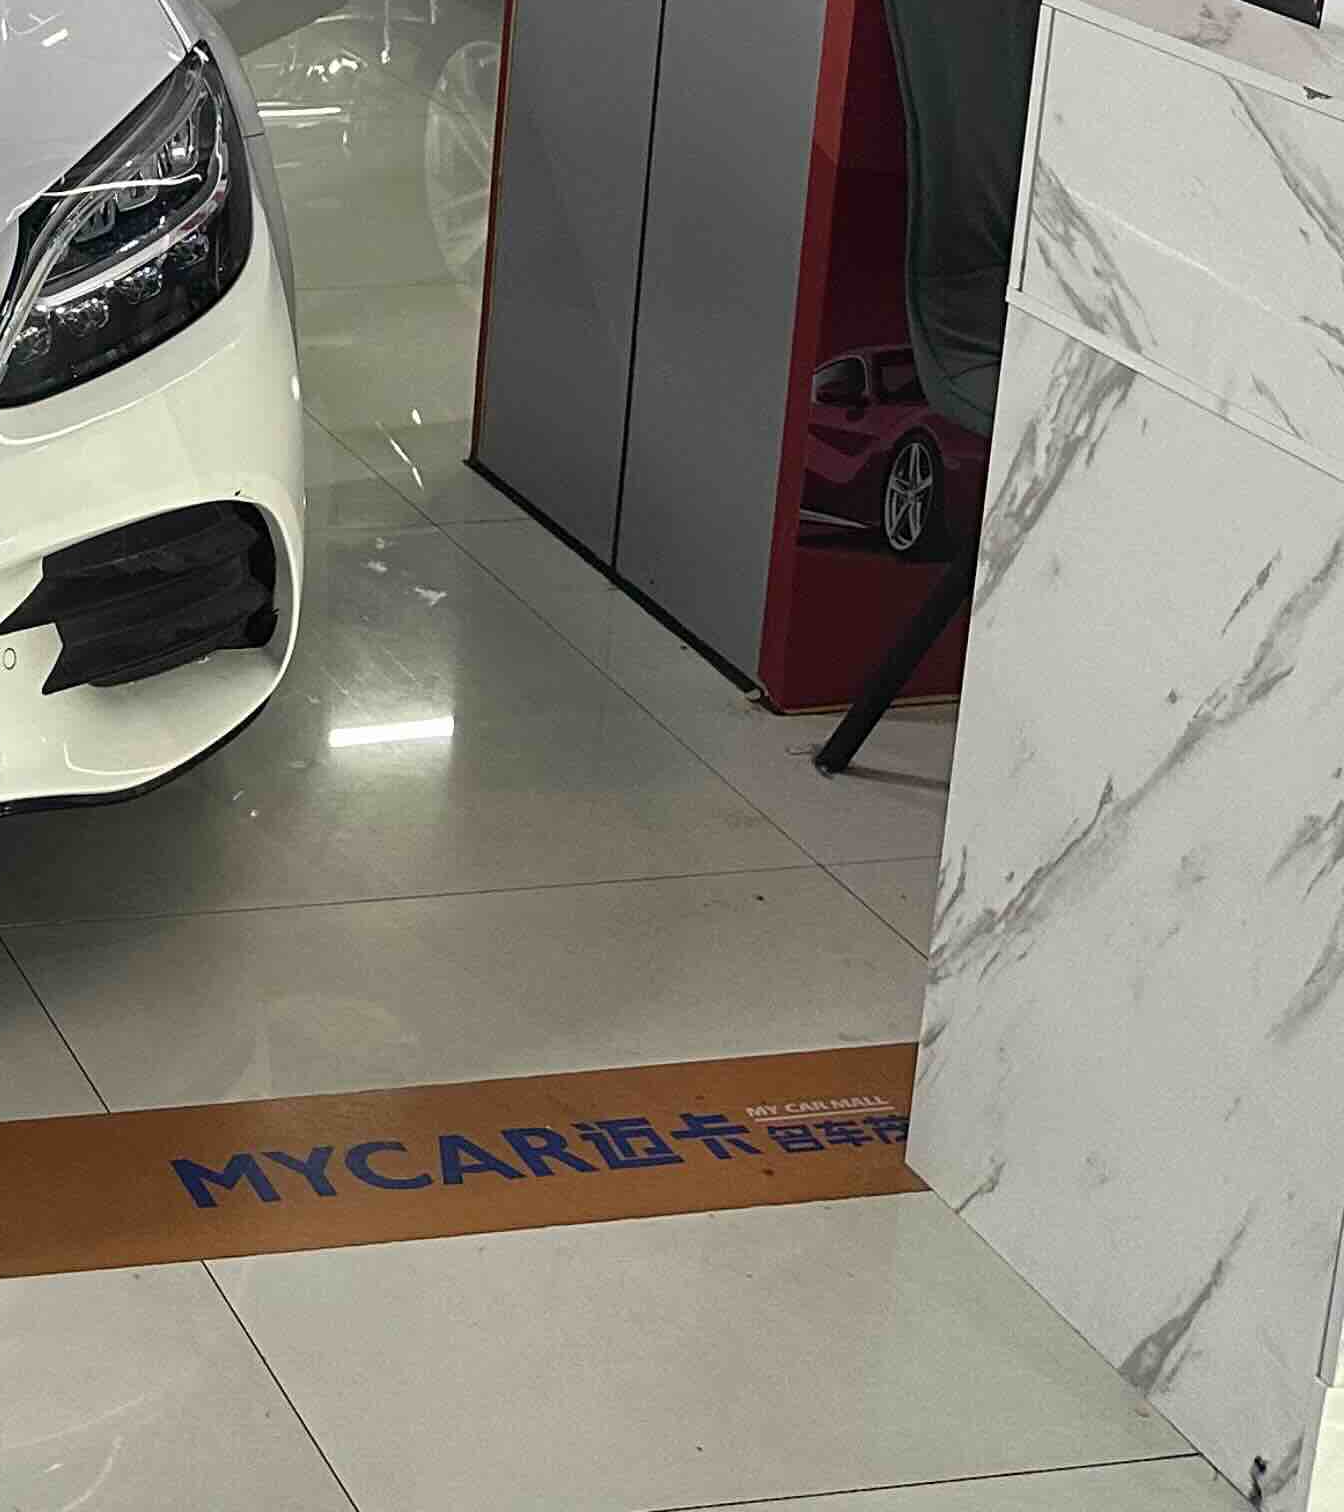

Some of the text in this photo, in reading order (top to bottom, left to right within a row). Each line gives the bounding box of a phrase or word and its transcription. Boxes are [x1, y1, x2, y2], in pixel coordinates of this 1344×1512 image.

[745, 1094, 890, 1118] MY CAR MALL
